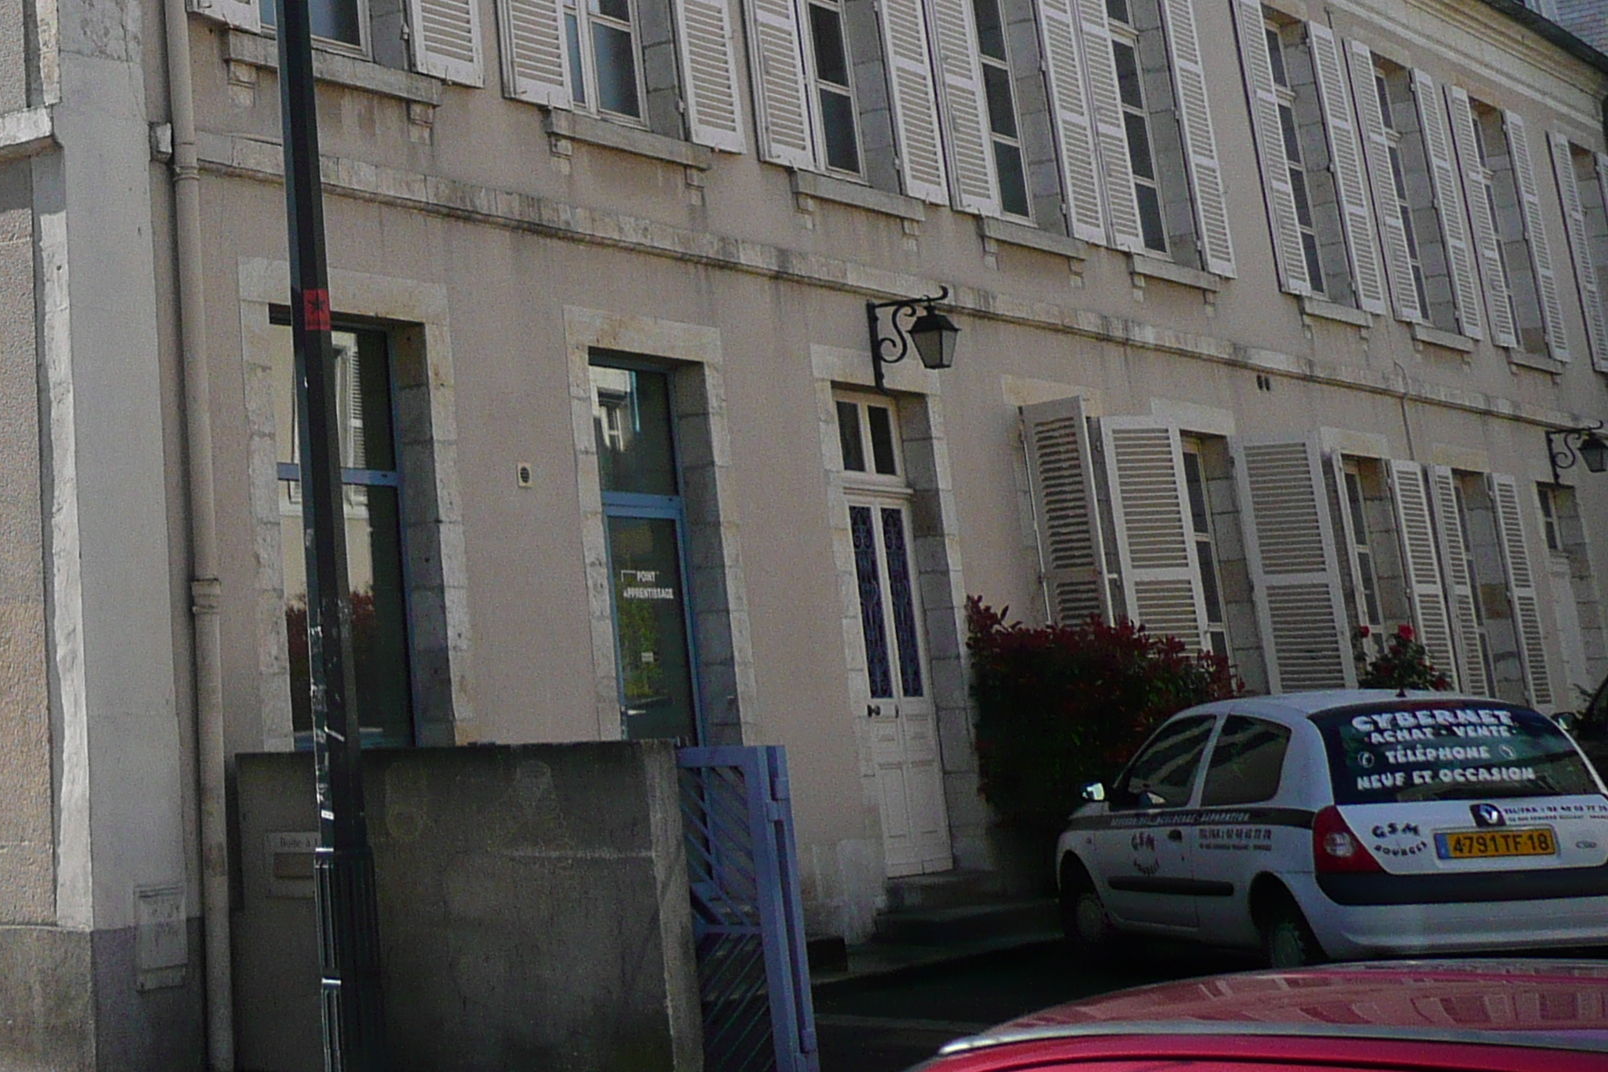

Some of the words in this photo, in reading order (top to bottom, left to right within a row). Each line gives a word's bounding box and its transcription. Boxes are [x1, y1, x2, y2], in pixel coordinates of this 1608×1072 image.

[1352, 709, 1515, 732] CYBERNET
[1371, 727, 1436, 745] ACHAT
[1452, 725, 1512, 738] VENTE
[1385, 743, 1491, 765] TÉLÉPHONE
[1357, 771, 1406, 791] NEUF
[1412, 769, 1433, 785] ET
[1439, 767, 1536, 783] OCCASION
[1371, 822, 1421, 838] GSM
